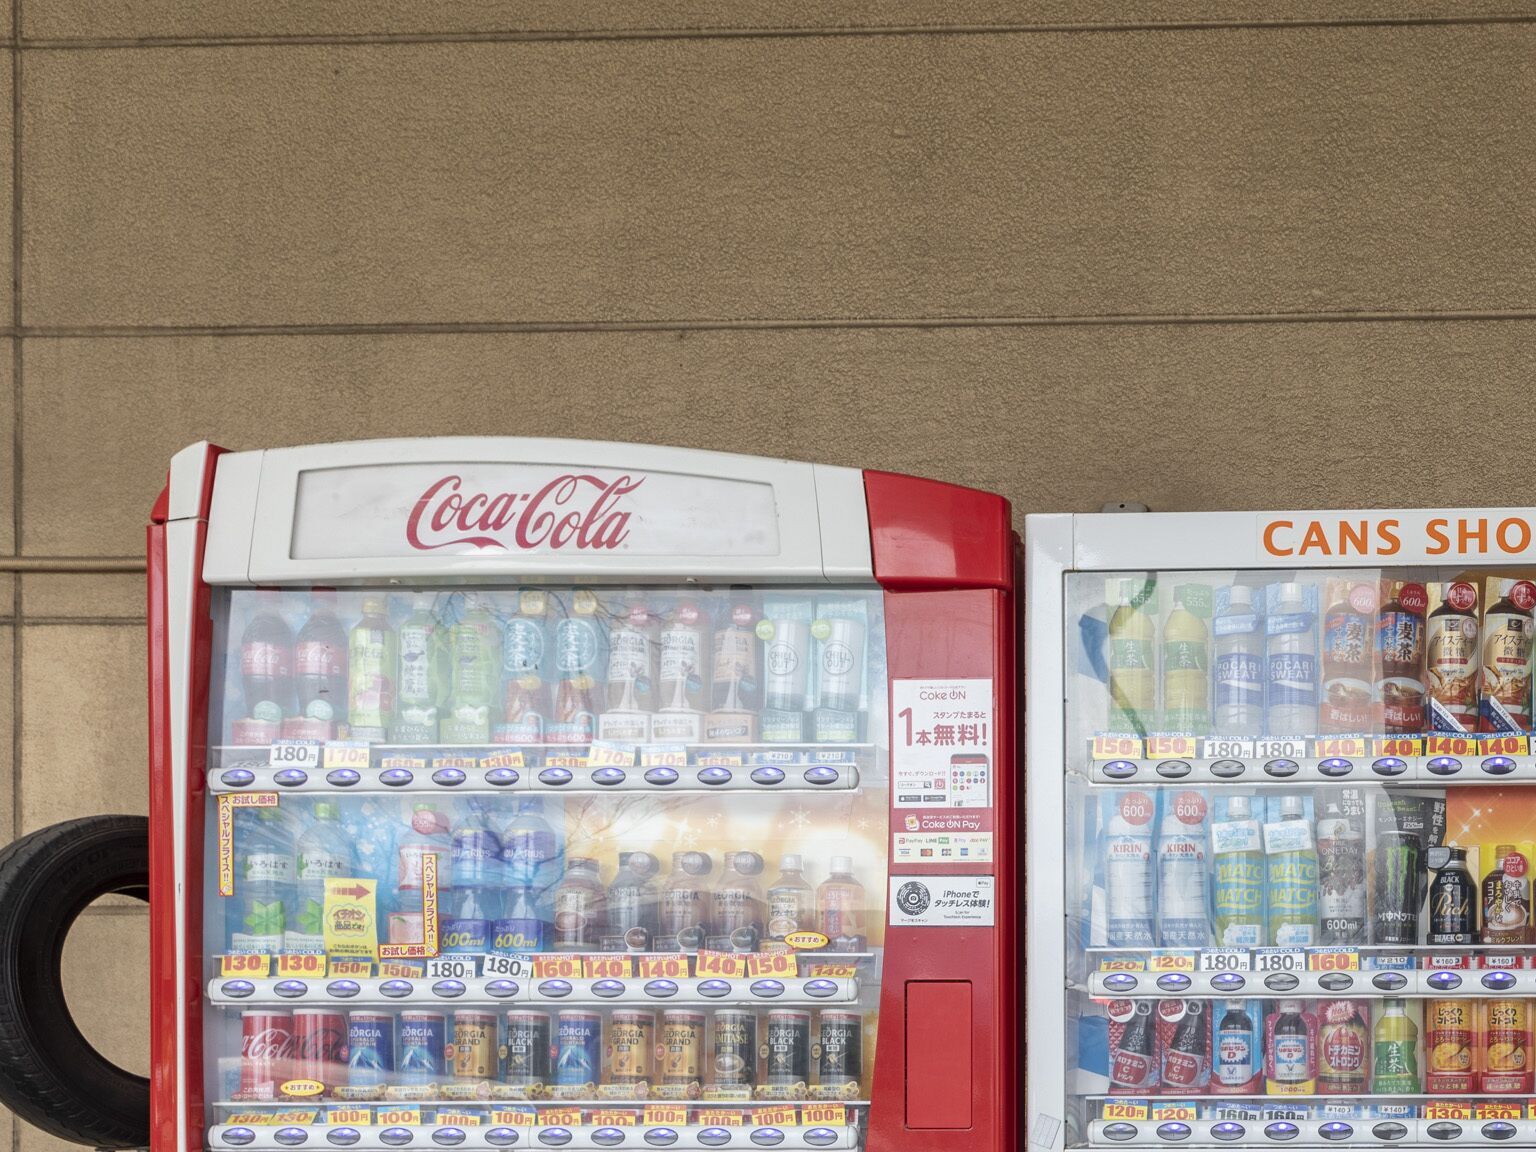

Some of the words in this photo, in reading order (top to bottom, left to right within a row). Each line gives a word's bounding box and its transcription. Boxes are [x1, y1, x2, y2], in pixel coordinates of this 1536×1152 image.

[1263, 520, 1401, 556] CANS
[920, 691, 947, 700] Coke
[1095, 739, 1140, 755] 150円
[1207, 742, 1250, 757] 180円
[1260, 742, 1303, 757] 180円
[1317, 740, 1363, 755] 140円
[1375, 739, 1421, 755] 140円
[1428, 738, 1474, 755] 140円
[1480, 737, 1526, 754] 140円
[273, 747, 316, 762] 180円
[922, 821, 945, 829] Coke
[963, 821, 980, 830] Pay
[1113, 843, 1142, 853] KIRIN
[1167, 843, 1196, 853] KIRIN
[1326, 919, 1358, 931] 600ml
[224, 956, 267, 972] 130円
[280, 956, 324, 972] 130円
[333, 963, 368, 974] 150円
[431, 961, 473, 977] 180円
[487, 959, 528, 977] 180円
[534, 961, 580, 977] 160円
[586, 961, 630, 977] 140円
[642, 961, 687, 977] 140円
[699, 958, 743, 976] 140円
[749, 956, 795, 974] 150円
[1204, 954, 1248, 971] 180円
[1259, 954, 1302, 971] 180円
[1311, 953, 1357, 969] 160円
[1387, 1044, 1401, 1072] 生茶
[330, 1111, 368, 1123] 100円
[647, 1111, 684, 1123] 100円
[804, 1109, 843, 1121] 100円
[1107, 1104, 1144, 1118] 120円
